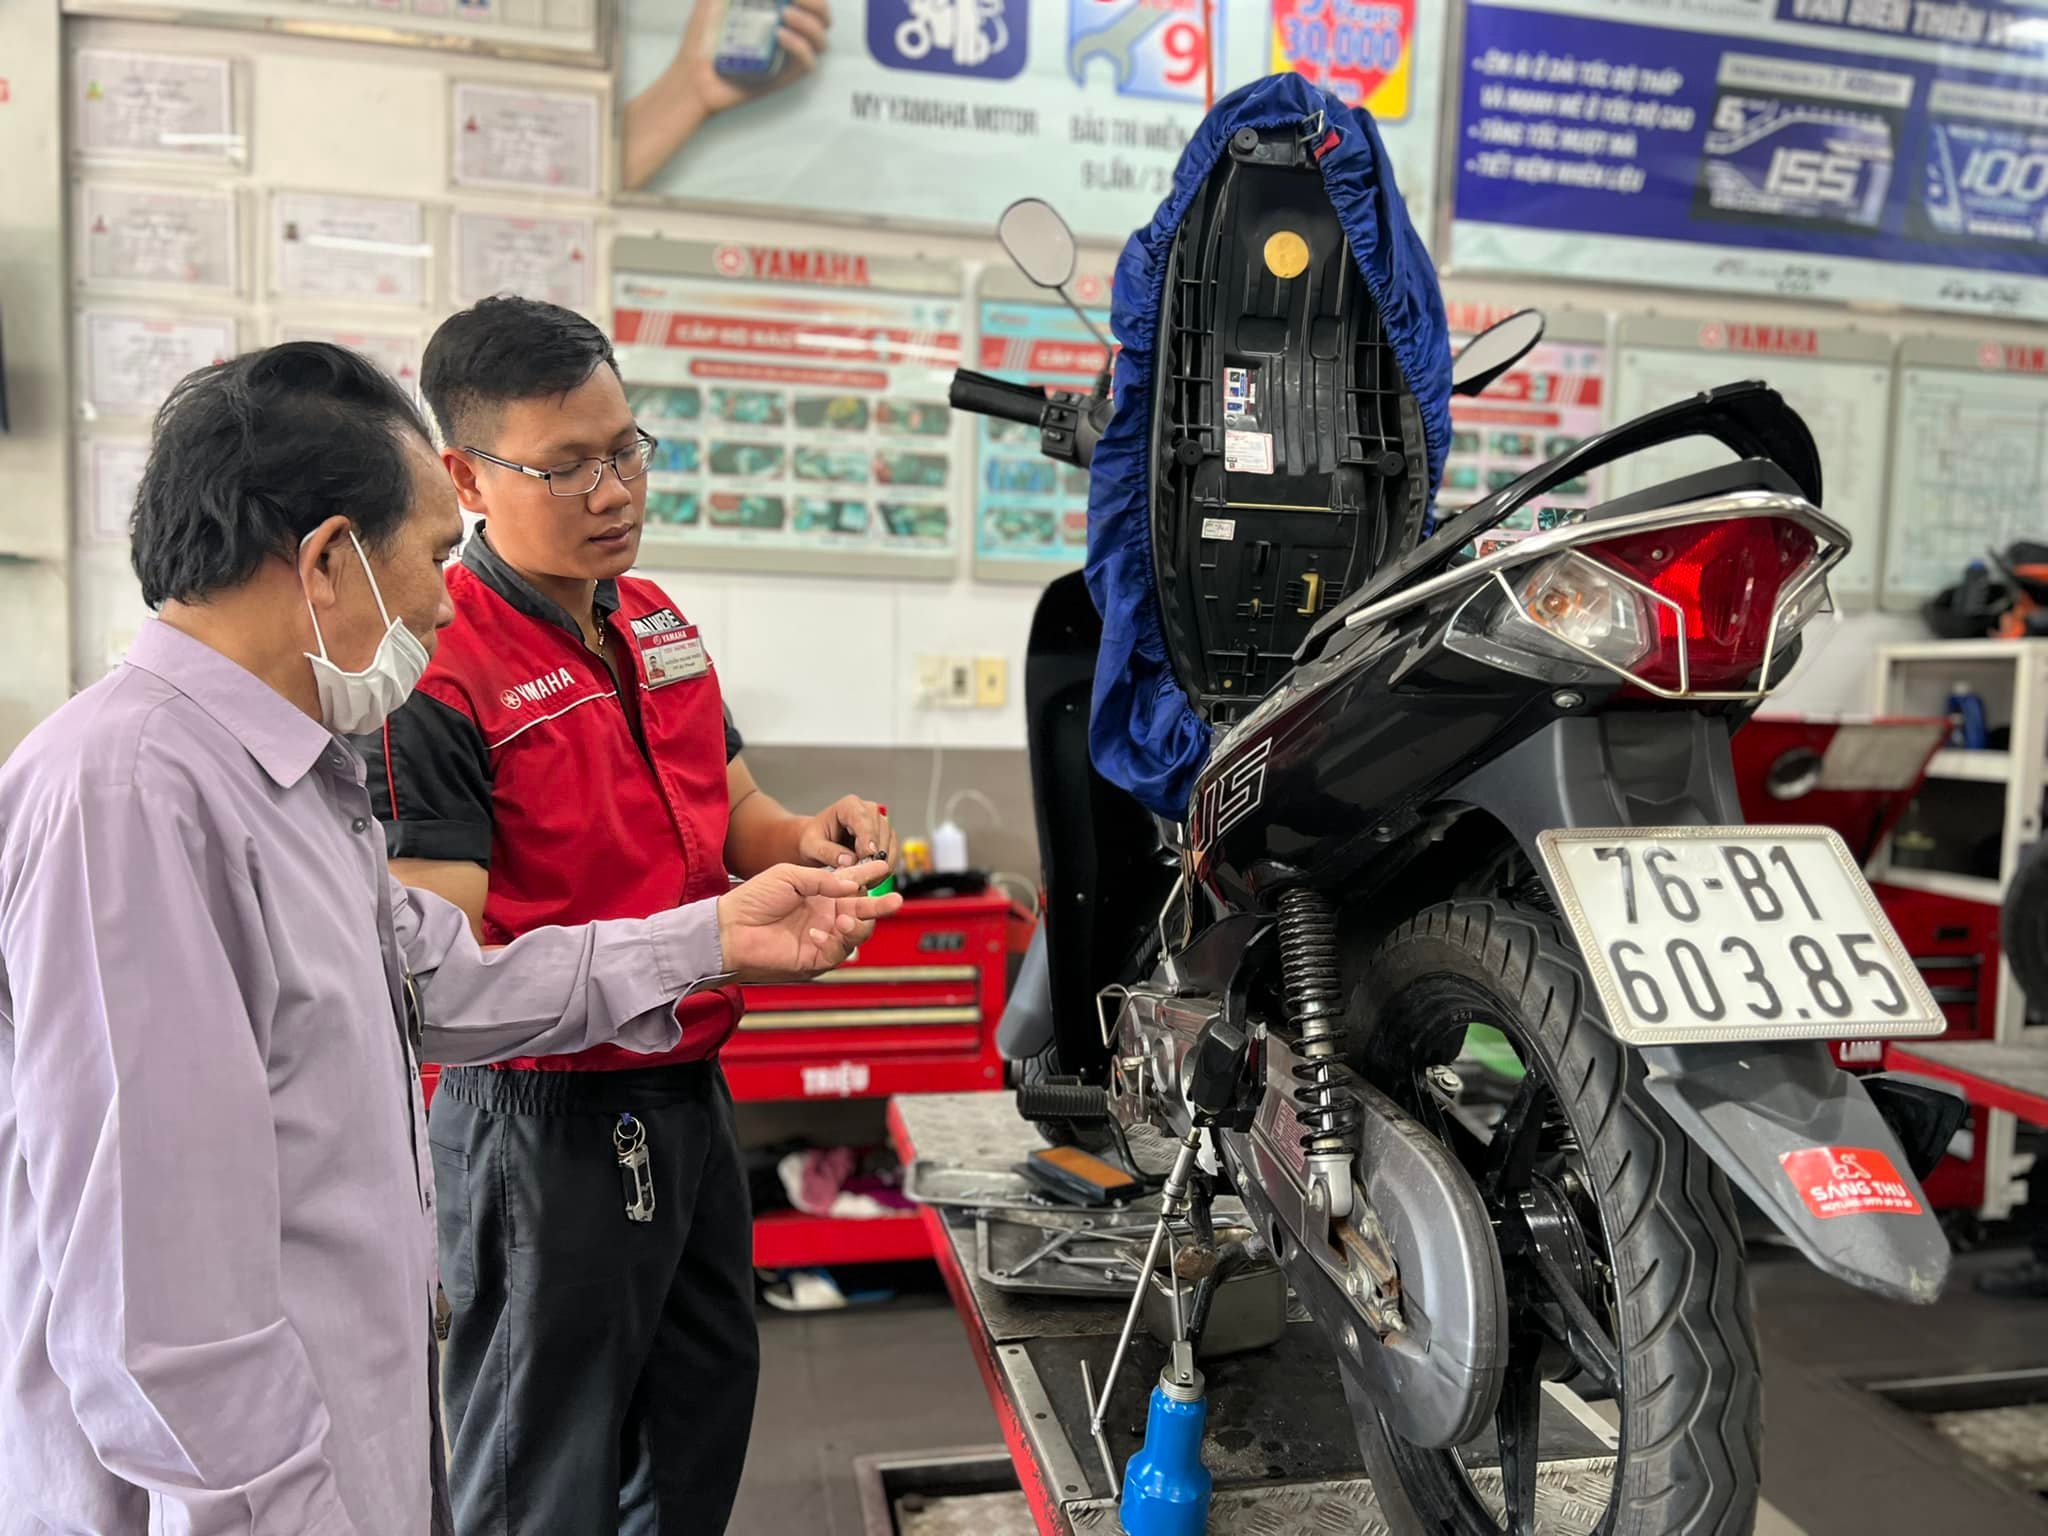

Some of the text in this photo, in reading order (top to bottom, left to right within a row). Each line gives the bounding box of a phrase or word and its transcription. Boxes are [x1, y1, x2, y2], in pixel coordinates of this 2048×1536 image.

[1162, 21, 1208, 84] 9
[1764, 146, 1862, 203] 155
[750, 248, 869, 287] YAMAHA
[1725, 321, 1818, 355] YAMAHA
[661, 630, 687, 644] YAMAHA
[513, 667, 576, 702] YMAHA
[1593, 845, 1823, 924] 76-B1
[1608, 933, 1909, 1024] 603.85
[1810, 1180, 1907, 1202] SÁNG THU
